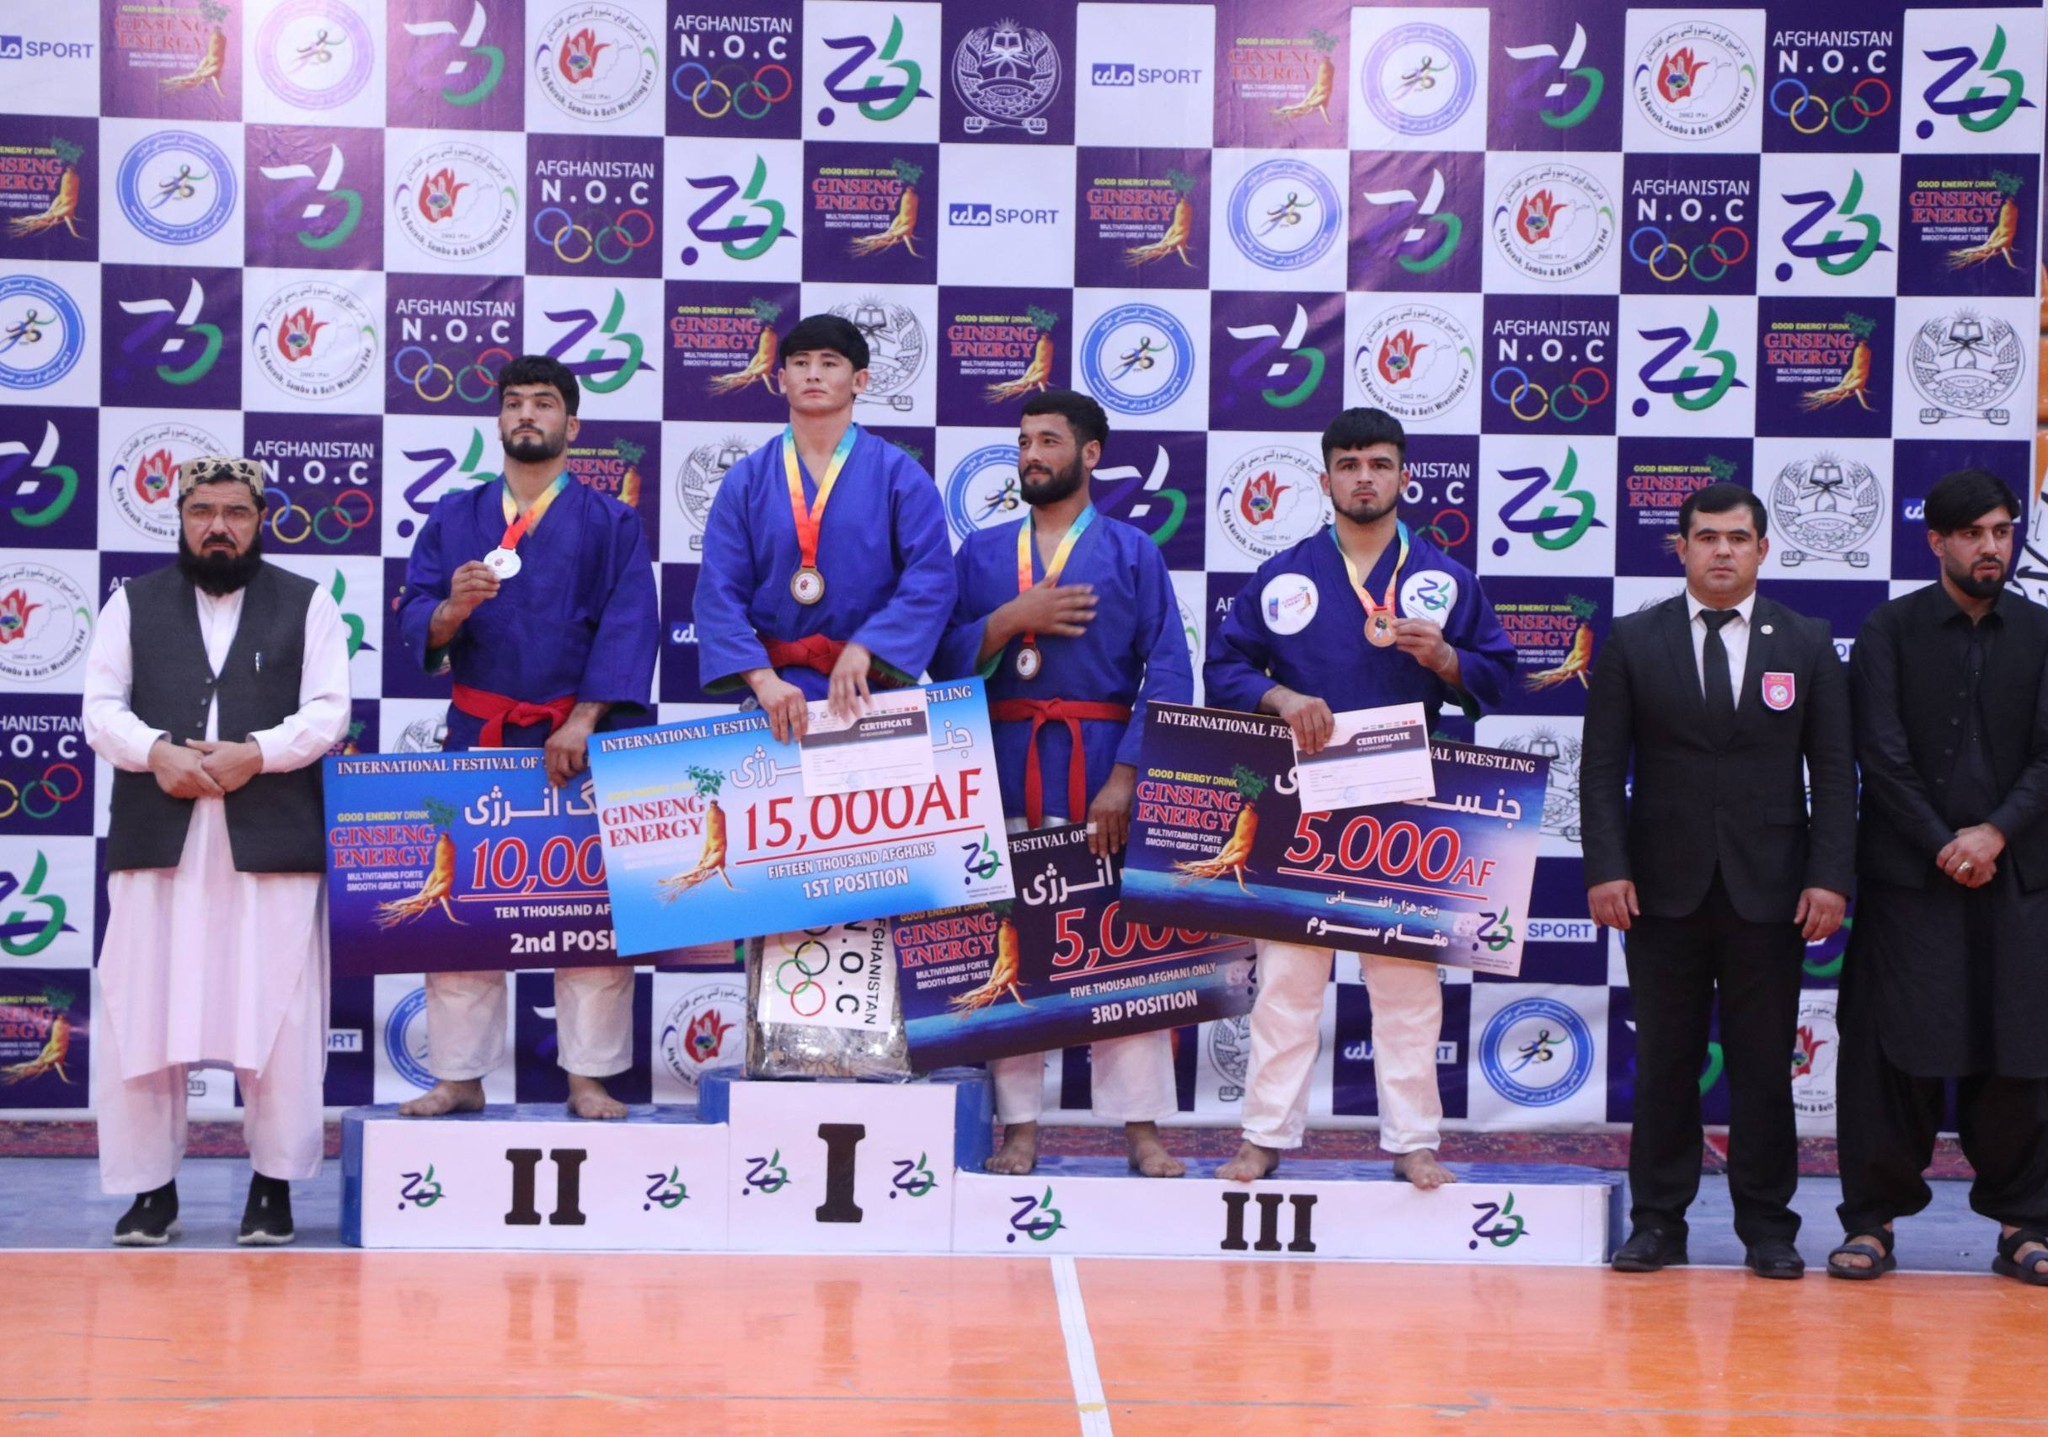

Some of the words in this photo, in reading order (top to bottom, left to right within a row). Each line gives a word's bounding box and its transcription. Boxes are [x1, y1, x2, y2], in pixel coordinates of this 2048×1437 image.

[674, 14, 792, 33] AFGHANISTAN
[1772, 30, 1893, 47] AFGHANISTAN
[26, 41, 94, 58] SPORT
[1138, 68, 1202, 84] SPORT
[535, 160, 654, 178] AFGHANISTAN
[0, 175, 58, 192] ERGY
[812, 178, 902, 194] GINSENG
[1631, 179, 1750, 196] AFGHANISTAN
[815, 195, 899, 211] ENERGY
[1087, 188, 1176, 205] GINSENG
[1909, 191, 2002, 206] GINSENG
[995, 208, 1059, 224] SPORT
[1090, 205, 1173, 221] ENERGY
[1912, 208, 1998, 223] ENERGY
[396, 298, 516, 317] AFGHANISTAN
[671, 316, 761, 333] GINSENG
[948, 325, 1037, 341] GINSENG
[1492, 319, 1610, 336] AFGHANISTAN
[674, 333, 757, 349] ENERGY
[1764, 332, 1855, 349] GINSENG
[951, 341, 1034, 358] ENERGY
[1767, 348, 1851, 365] ENERGY
[252, 440, 374, 458] AFGHANISTAN
[567, 459, 624, 474] SENG
[1404, 462, 1470, 478] NISTAN
[1629, 492, 1692, 507] ENER
[1507, 631, 1574, 646] NERGY
[926, 684, 972, 703] STLING
[0, 716, 83, 732] HANISTAN
[860, 718, 912, 731] CERTIFICATE
[1157, 710, 1266, 736] INTERNATIONAL
[601, 725, 710, 752] INTERNATIONAL
[713, 716, 770, 736] FESTIVA
[1356, 732, 1410, 746] CERTIFICATE
[337, 759, 450, 775] INTERNATIONAL
[453, 757, 518, 772] FESTIVAL
[521, 756, 538, 770] OF
[1455, 751, 1536, 774] WRESTLING
[1148, 768, 1174, 780] GOOD
[1175, 771, 1212, 784] ENERGY
[1213, 776, 1238, 788] DRINK
[1136, 780, 1242, 812] GINSENG
[337, 812, 364, 822] GOOD
[366, 812, 402, 821] ENERGY
[404, 810, 430, 820] DRINK
[602, 794, 705, 826] GINSENG
[1137, 802, 1236, 832] ENERGY
[329, 824, 436, 848] GINSENG
[608, 817, 703, 848] ENERGY
[1070, 830, 1088, 843] OF
[1148, 828, 1198, 841] MULTIVITAMINS
[1199, 834, 1222, 844] FORTE
[1146, 838, 1176, 848] SMOOTH
[1176, 842, 1199, 852] GREAT
[334, 846, 433, 868] ENERGY
[472, 834, 606, 896] 10,00
[768, 862, 814, 880] FIFTEEN
[816, 852, 880, 871] THOUSAND
[882, 842, 936, 862] AFGHANS
[400, 870, 424, 879] FORTE
[802, 880, 830, 899] 1ST
[834, 866, 909, 894] POSITION
[494, 906, 519, 918] TEN
[522, 904, 592, 918] THOUSAND
[1395, 900, 1416, 916] هزار
[894, 912, 998, 948] GINSENG
[1306, 916, 1380, 938] سوم
[1384, 923, 1448, 947] مقام
[1528, 923, 1592, 938] SPORT
[510, 931, 555, 954] 2nd
[562, 930, 616, 952] POSI
[900, 934, 996, 968] ENERGY
[864, 918, 886, 1025] FGHANISTAN
[916, 964, 966, 980] MULTIVITAMINS
[967, 960, 990, 971] FORTE
[916, 977, 946, 990] SMOOTH
[946, 974, 970, 985] GREAT
[971, 970, 992, 980] TASTE
[1070, 987, 1092, 999] FIVE
[1094, 976, 1146, 994] THOUSAND
[1148, 968, 1192, 985] AFGHANI
[1192, 962, 1216, 976] ONLY
[1092, 1004, 1122, 1024] 3RD
[1126, 990, 1198, 1018] POSITION
